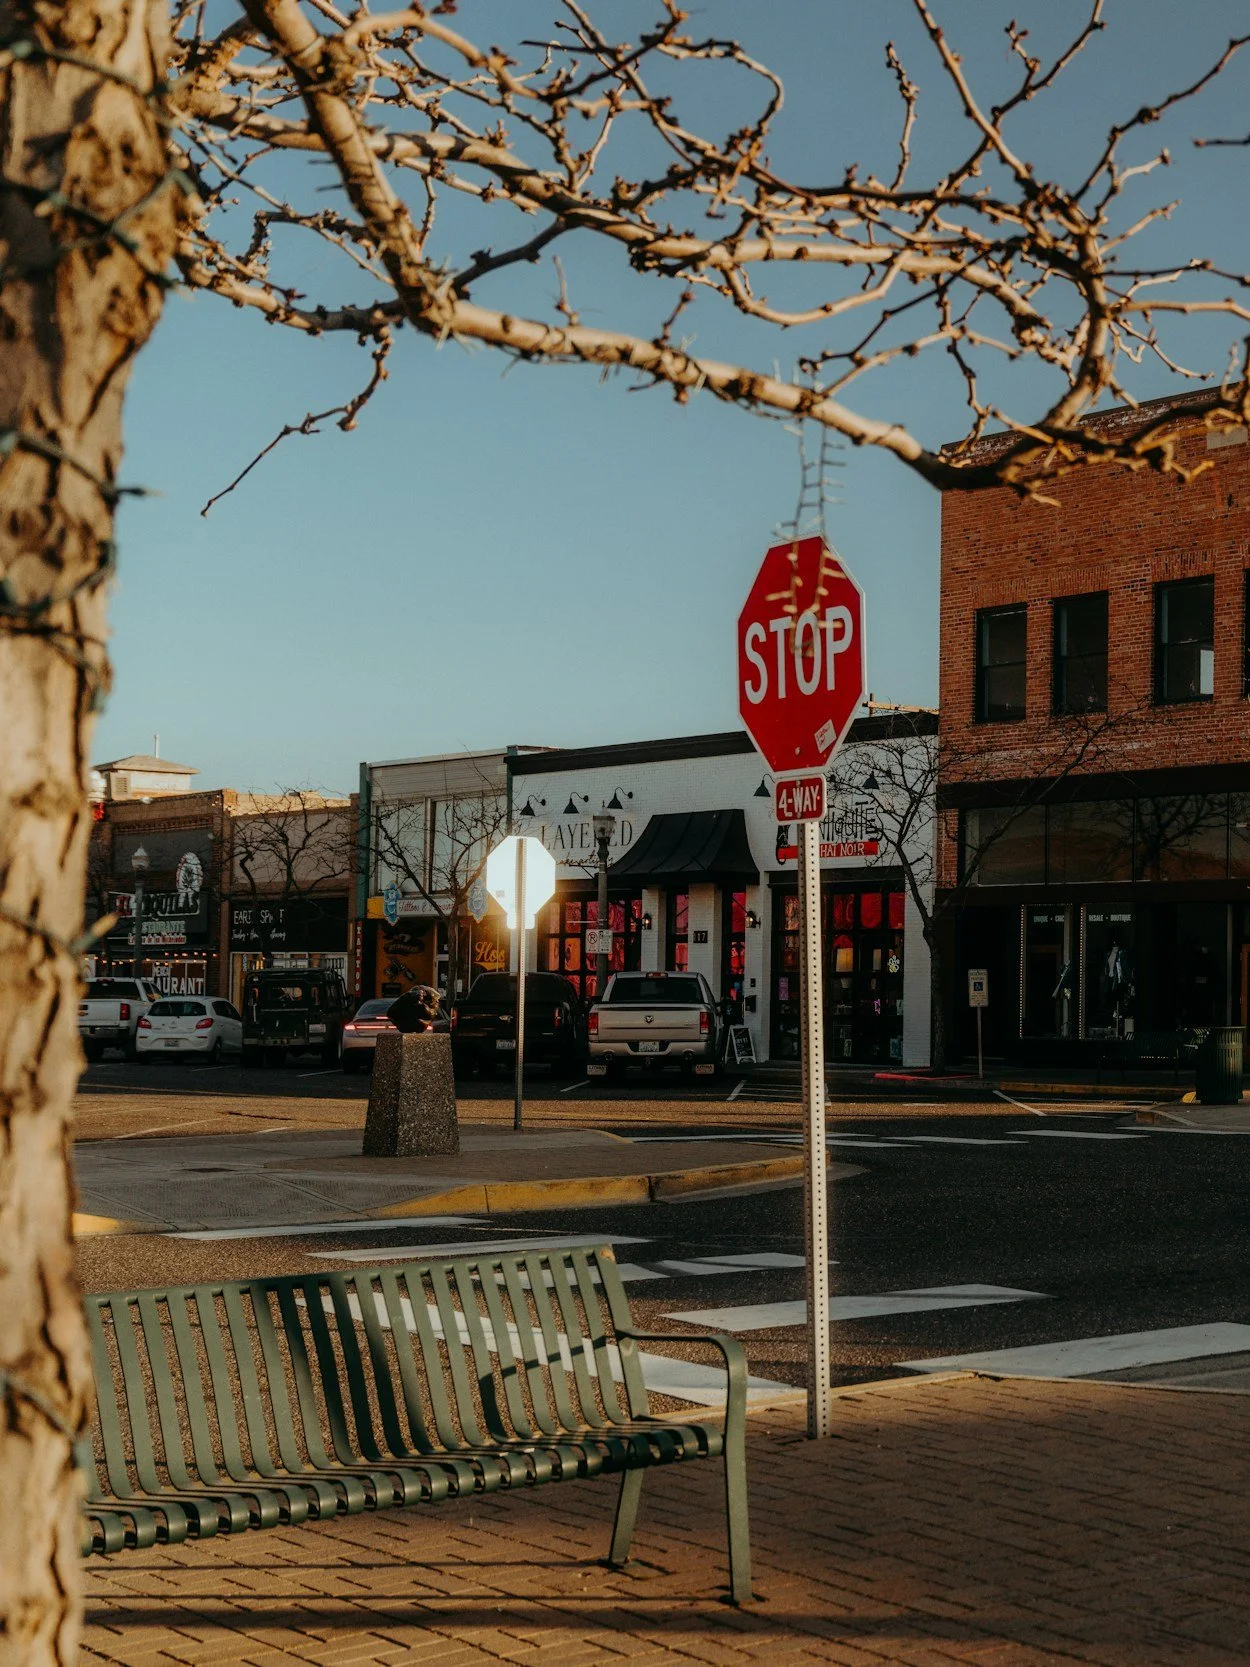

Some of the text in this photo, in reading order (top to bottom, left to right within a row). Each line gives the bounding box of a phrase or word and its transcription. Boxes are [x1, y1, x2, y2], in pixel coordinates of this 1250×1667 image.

[744, 605, 853, 705] STOP
[778, 785, 819, 817] 4-WAY
[541, 820, 633, 851] LAYEED
[820, 842, 865, 857] HAT NOIR
[1110, 914, 1131, 922] BOUTIQUE
